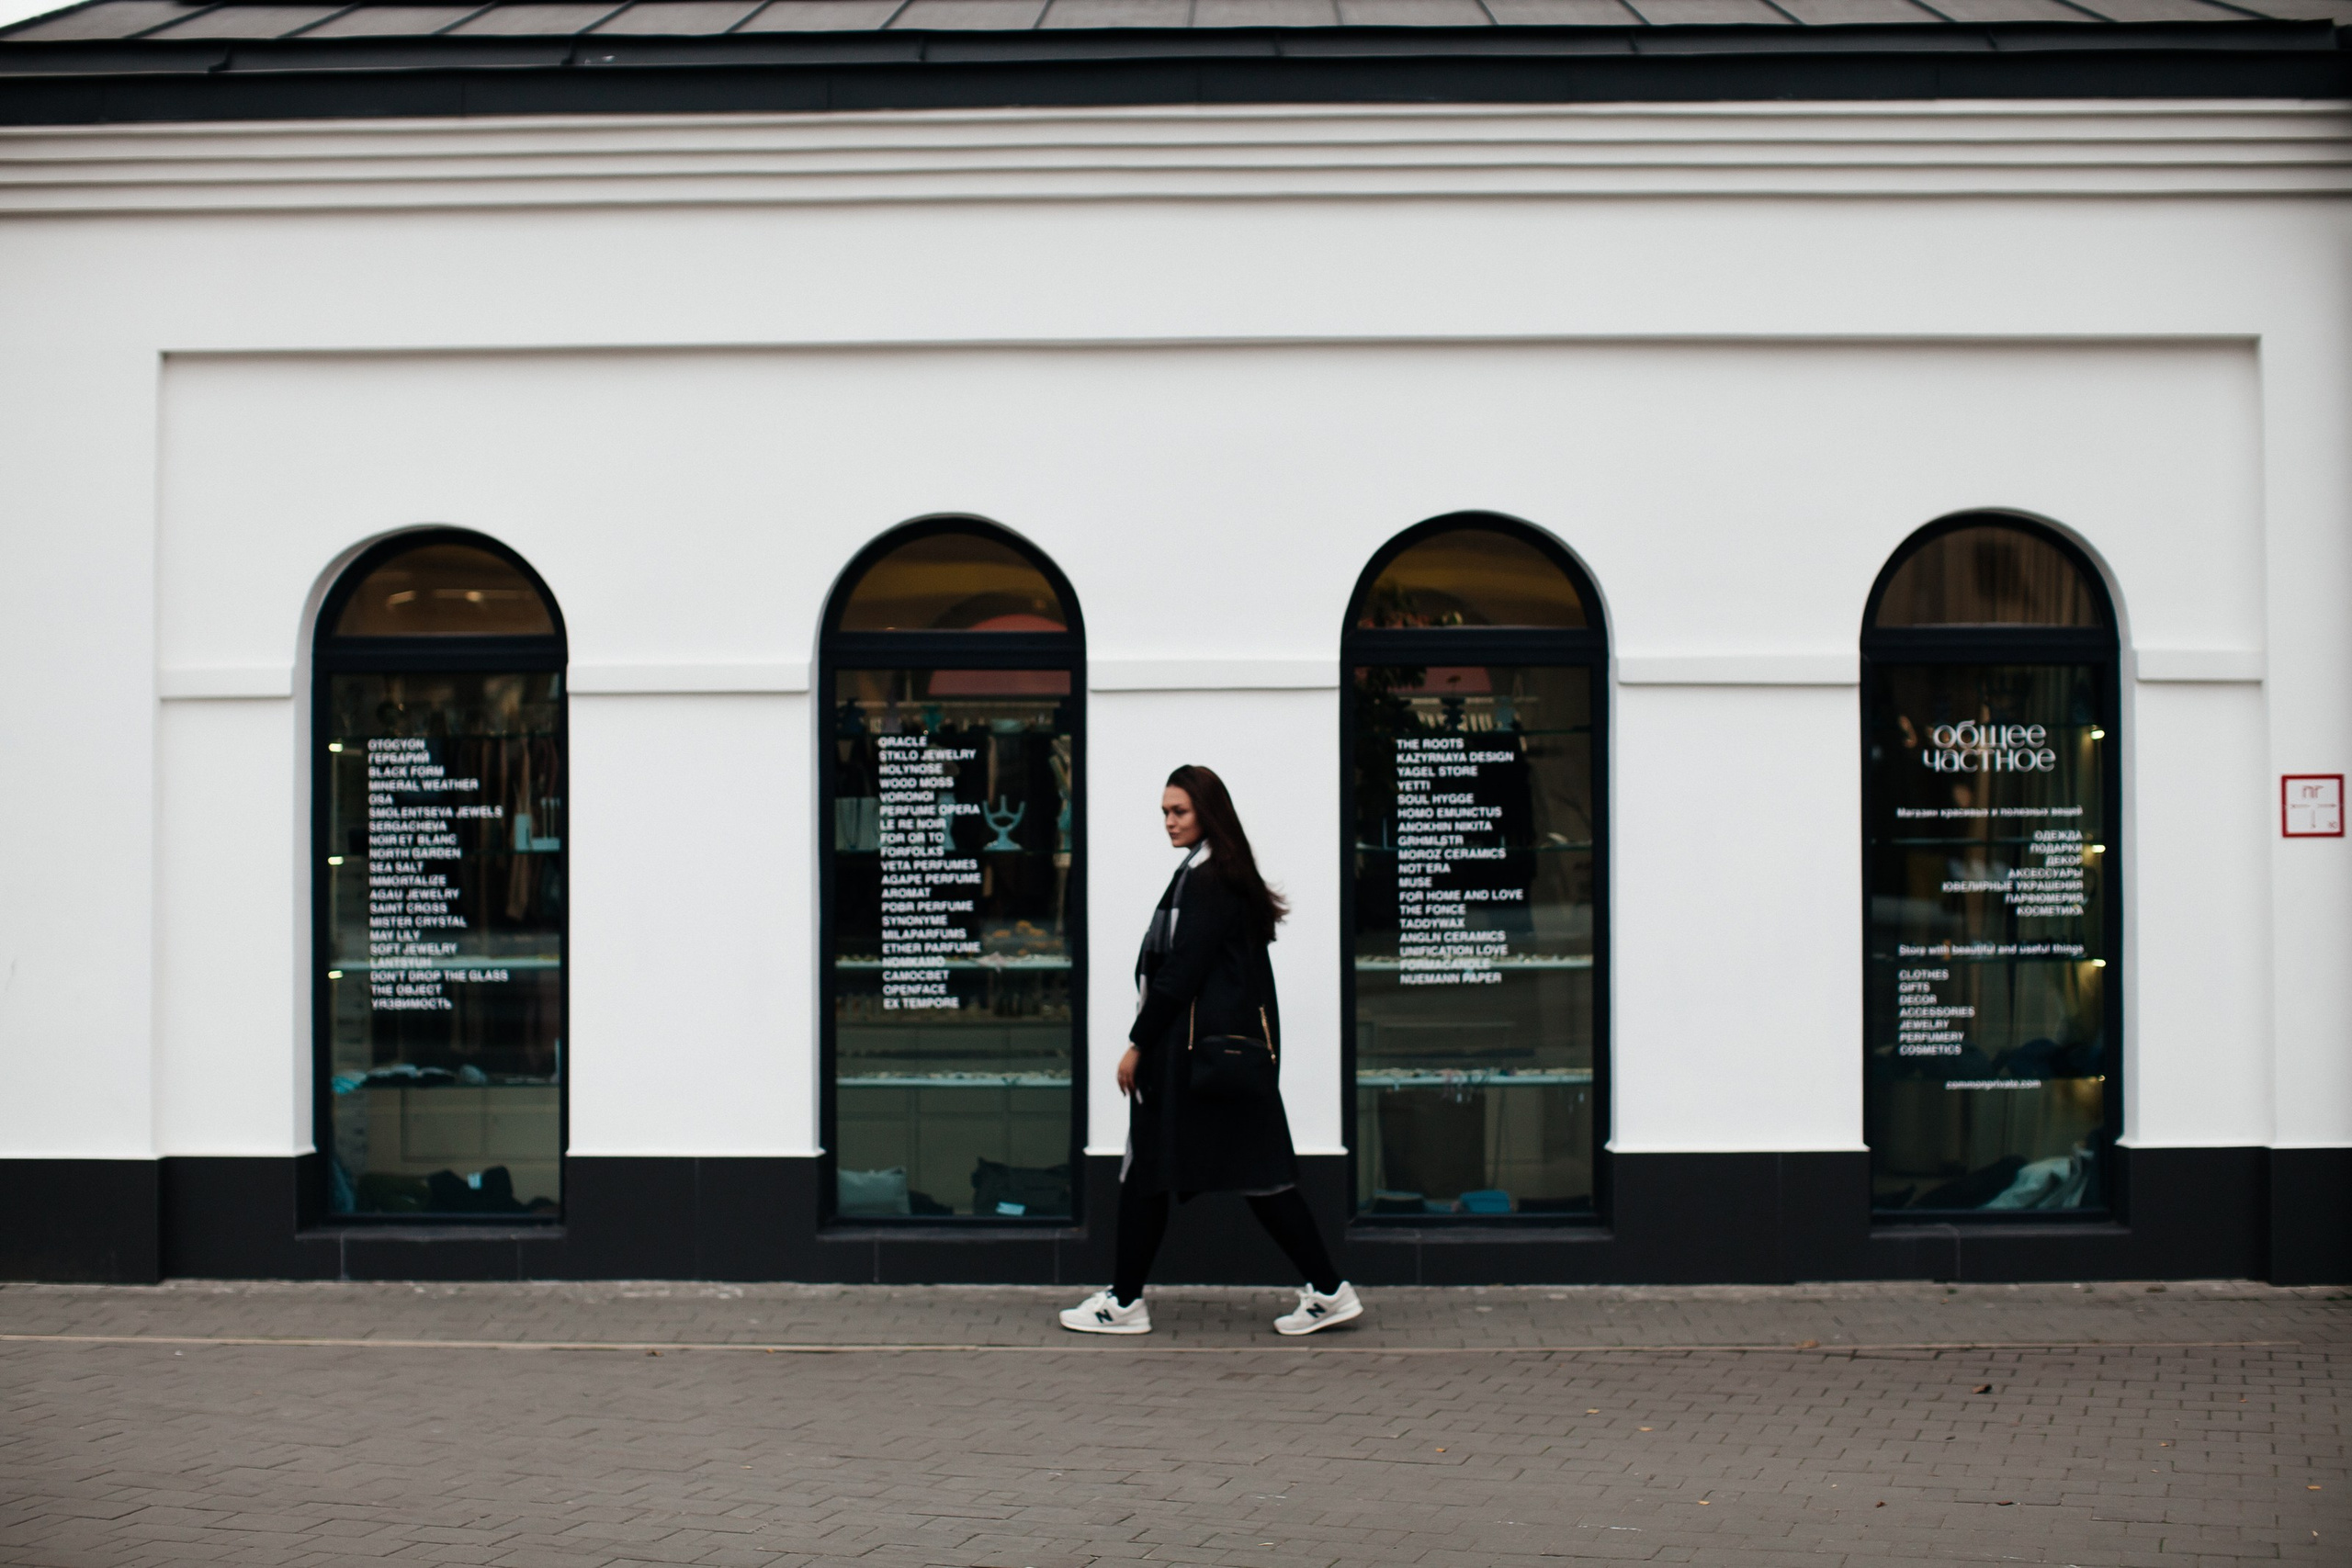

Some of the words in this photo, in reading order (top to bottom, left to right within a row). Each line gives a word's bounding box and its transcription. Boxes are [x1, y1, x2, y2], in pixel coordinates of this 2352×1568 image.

[1933, 720, 2046, 750] общее
[878, 737, 927, 748] ORACLE
[1396, 739, 1419, 750] THE
[1422, 739, 1464, 750] ROOTS
[878, 750, 919, 761] STKLO
[921, 749, 976, 761] JEWELRY
[1469, 751, 1514, 761] DESIGN
[1923, 748, 2056, 773] частное
[368, 766, 408, 778] BLACK
[411, 765, 445, 777] FORM
[1397, 767, 1435, 777] YAGEL
[1438, 766, 1478, 777] STORE
[368, 780, 420, 792] MINERAL
[422, 778, 479, 790] WEATHER
[879, 778, 917, 788] WOOD
[919, 777, 954, 788] MOSS
[1397, 795, 1430, 805] SOUL
[1432, 794, 1474, 805] HYGGE
[368, 807, 453, 818] SMOLENTSEVA
[456, 805, 503, 818] JEWELS
[879, 806, 935, 816] PERFUME
[939, 804, 980, 815] OPERA
[1397, 808, 1434, 818] HOMO
[1897, 807, 1939, 818] Магазин
[368, 820, 447, 832] SERGACHEVA
[880, 819, 895, 830] LE
[917, 818, 946, 829] NOIR
[1454, 821, 1493, 831] NIKITA
[369, 835, 397, 846] NOIR
[399, 835, 413, 845] ET
[417, 834, 458, 845] BLANC
[880, 833, 905, 844] FOR
[908, 832, 925, 843] OR
[928, 832, 944, 843] TO
[2034, 829, 2083, 842] ОДЕЖДА
[369, 849, 410, 860] NORTH
[412, 847, 461, 859] GARDEN
[880, 846, 944, 858] FORFOLKS
[1398, 849, 1442, 860] MOROZ
[1444, 848, 1506, 859] CERAMICS
[2030, 842, 2083, 854] ПОДАРКИ
[881, 861, 910, 872] VETA
[913, 860, 978, 871] PERFUMES
[2045, 855, 2083, 867] ДЕКОР
[369, 862, 392, 874] SEA
[395, 862, 424, 873] SALT
[2007, 868, 2084, 879] АКСЕССУАРЫ
[369, 874, 447, 887] IMMORTALIZE
[881, 874, 922, 885] AGAPE
[925, 874, 981, 885] PERFUME
[1398, 877, 1432, 887] MUSE
[881, 887, 931, 898] AROMAT
[1941, 881, 2013, 893] ЮВЕЛИРНЫЕ
[2016, 880, 2084, 891] УКРАШЕНИЯ
[369, 889, 403, 900] AGAU
[406, 888, 459, 900] JEWELRY
[1399, 892, 1423, 902] FOR
[1427, 890, 1461, 901] HOME
[1464, 890, 1489, 900] AND
[1492, 889, 1523, 900] LOVE
[2005, 893, 2084, 905] ПАРФЮМЕРИЯ
[369, 902, 403, 914] SAINT
[406, 902, 447, 914] CROSS
[917, 901, 973, 911] PERFUME
[1399, 905, 1422, 915] THE
[2017, 906, 2084, 917] КОСМЕТИКА
[369, 917, 413, 928] MISTER
[414, 916, 467, 928] CRYSTAL
[369, 931, 393, 942] MAY
[396, 930, 421, 942] LILY
[1443, 931, 1506, 942] CERAMICS
[369, 943, 401, 955] SOFT
[402, 942, 458, 955] JEWELRY
[882, 943, 922, 953] ETHER
[924, 942, 981, 953] PARFUME
[1400, 946, 1473, 956] UNIFICATION
[1476, 944, 1508, 955] LOVE
[1899, 945, 1926, 956] Store
[1928, 945, 1950, 955] with
[1952, 944, 1996, 955] beautiful
[1998, 944, 2017, 954] and
[2020, 944, 2050, 954] useful
[2052, 943, 2084, 956] things
[370, 970, 405, 982] DON'T
[408, 970, 441, 982] DROP
[444, 970, 466, 982] THE
[469, 969, 508, 982] GLASS
[1462, 973, 1501, 984] PAPER
[1899, 969, 1949, 980] CLOTHES
[371, 984, 393, 996] THE
[396, 984, 442, 996] OBJECT
[883, 984, 946, 996] OPENFACE
[1899, 982, 1930, 993] GIFTS
[371, 998, 452, 1010] УЯЗВИМОСТЬ
[883, 998, 899, 1010] EX
[902, 998, 959, 1009] TEMPORE
[1899, 995, 1937, 1006] DECOR
[1899, 1007, 1974, 1018] ACCESSORIES
[1899, 1020, 1950, 1031] JEWELRY
[1899, 1032, 1964, 1043] PERFUMERY
[1899, 1044, 1962, 1055] COSMETICS
[1095, 1309, 1113, 1323] N
